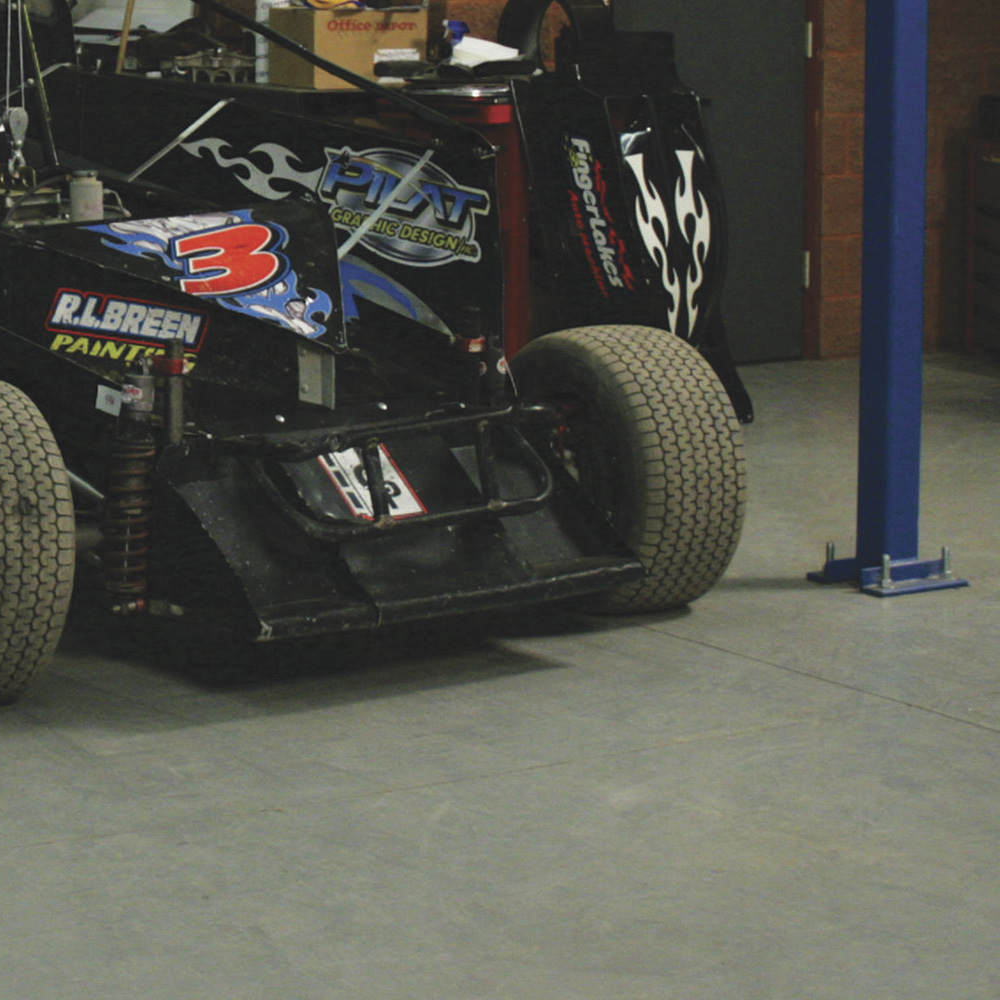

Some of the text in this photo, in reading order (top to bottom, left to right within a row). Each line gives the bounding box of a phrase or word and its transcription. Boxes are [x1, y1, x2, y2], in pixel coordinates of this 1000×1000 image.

[327, 19, 372, 32] Office
[330, 208, 398, 236] GRAHIC
[176, 223, 279, 295] 3
